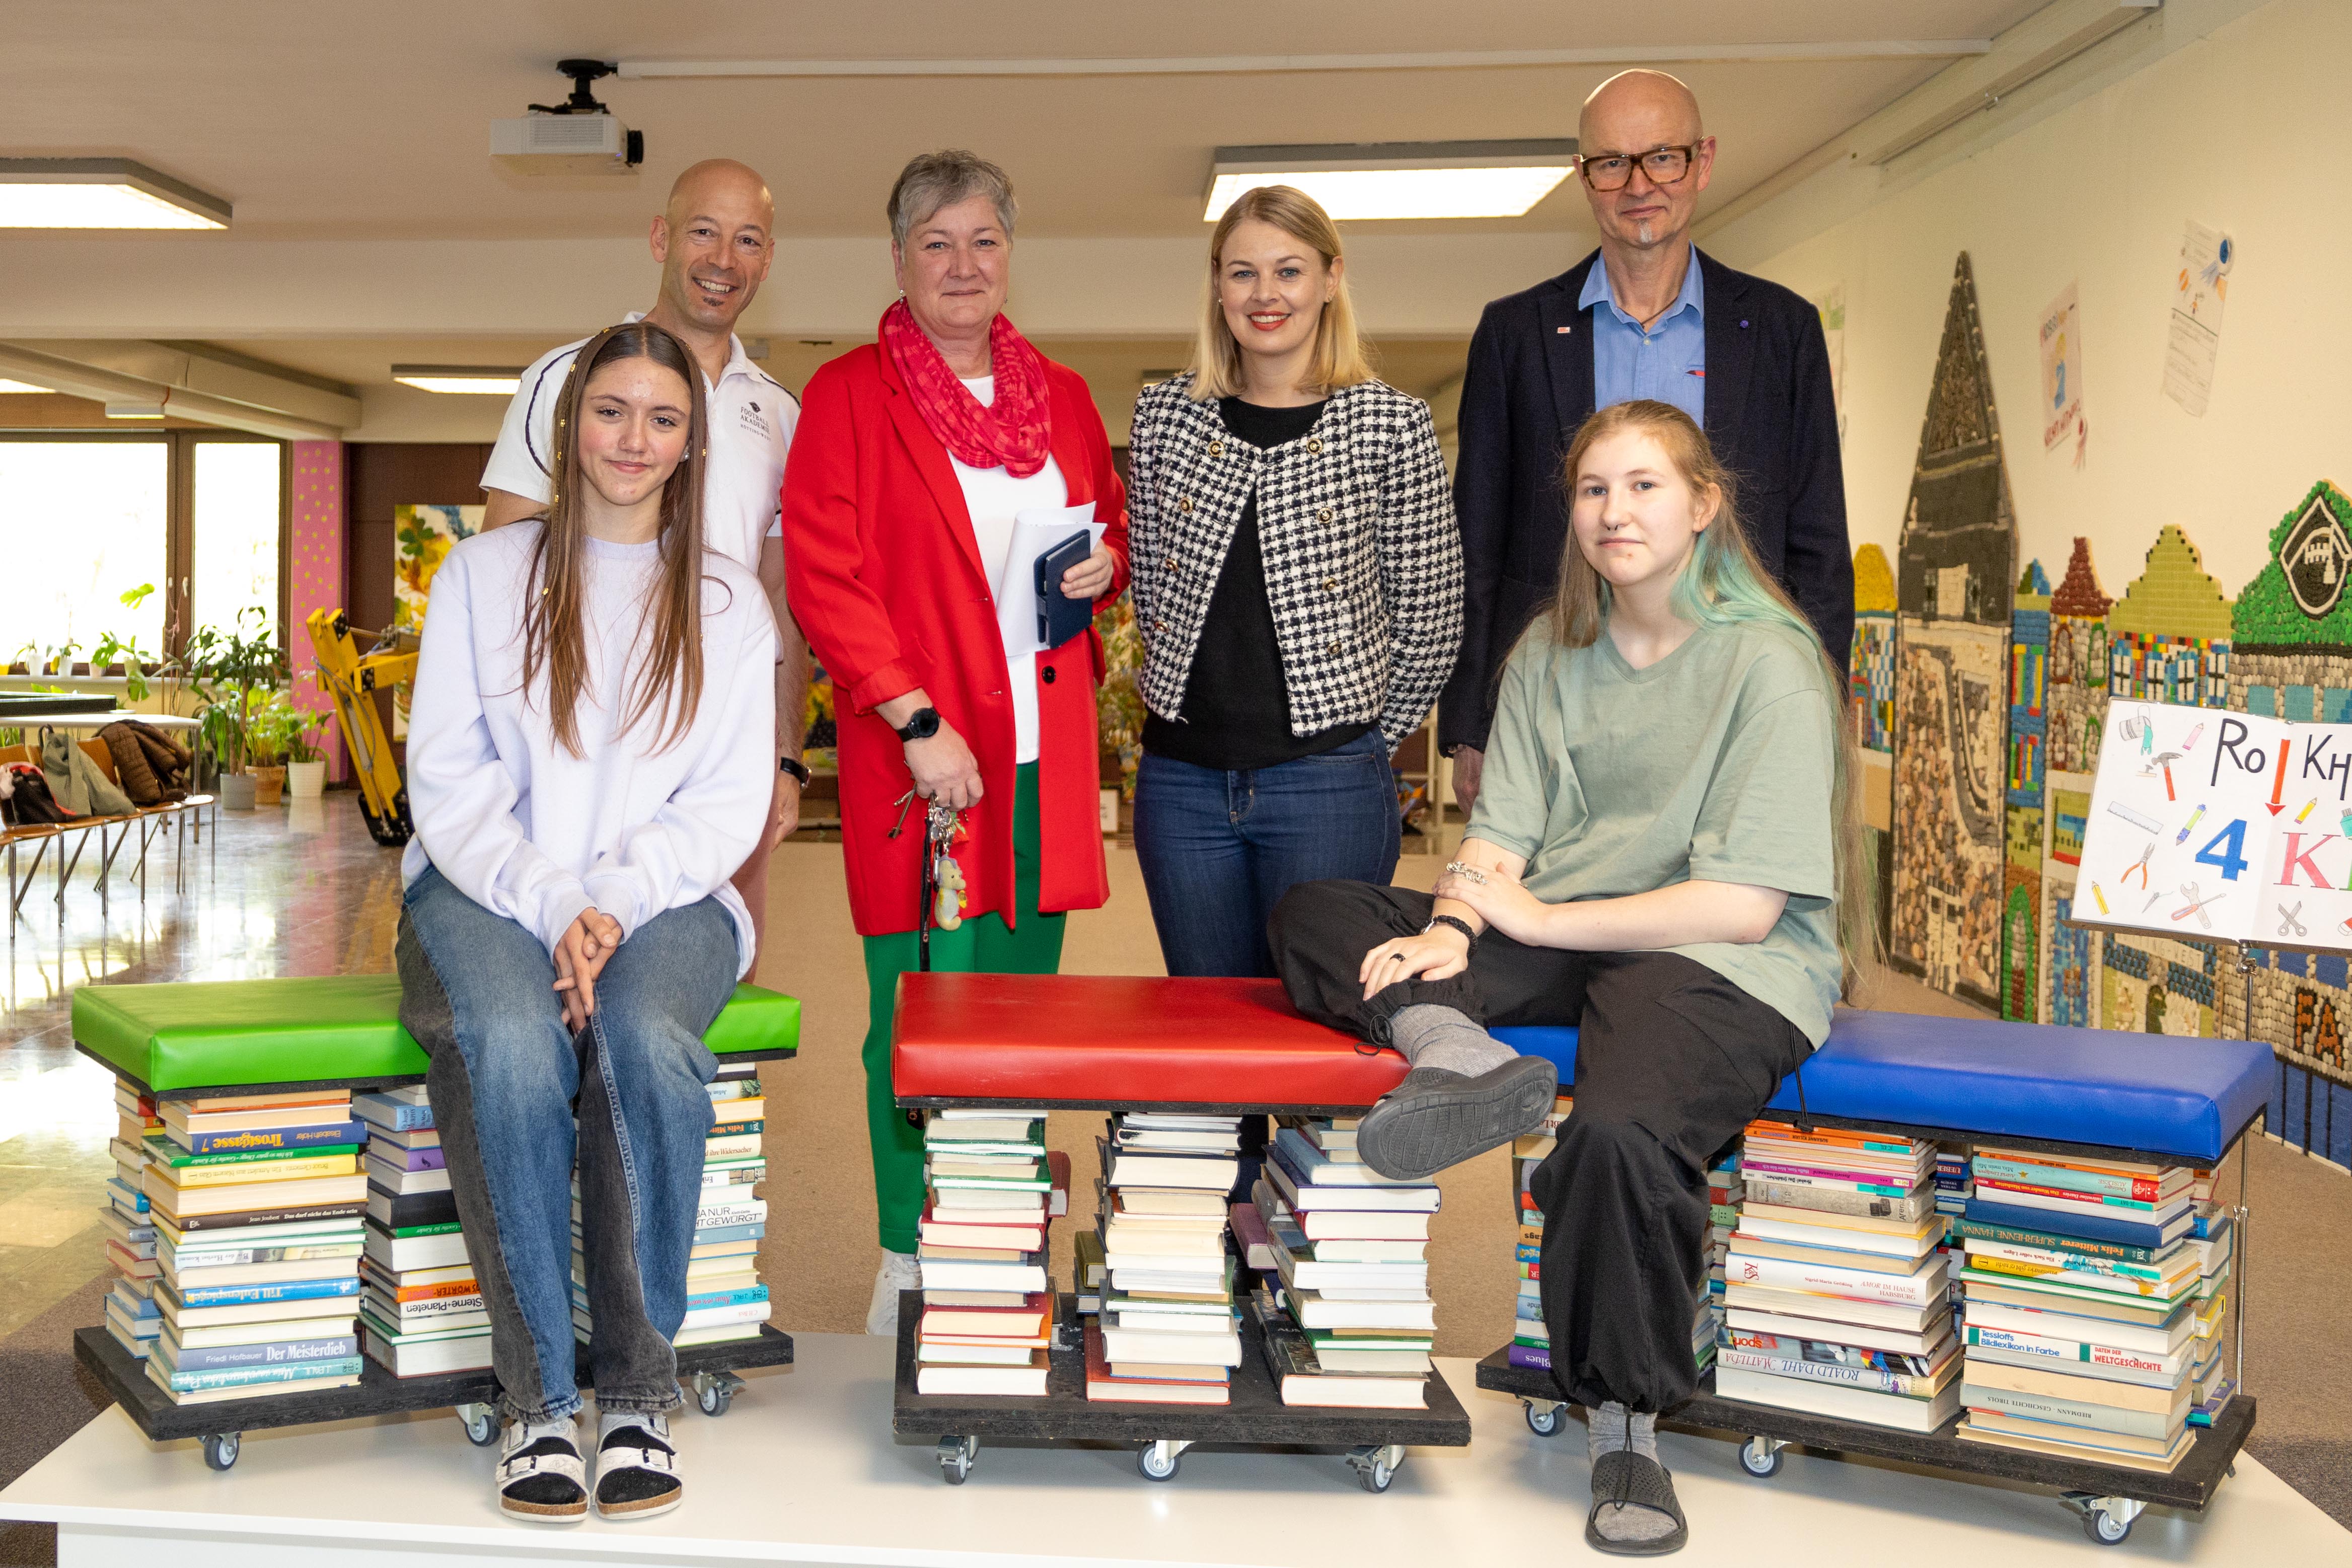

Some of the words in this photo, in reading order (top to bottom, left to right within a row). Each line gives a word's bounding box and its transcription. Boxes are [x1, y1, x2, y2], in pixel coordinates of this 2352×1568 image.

[741, 407, 770, 428] FOOTBALL
[741, 414, 770, 435] AKADEMIE
[2195, 818, 2248, 881] 4
[2273, 832, 2352, 891] K
[727, 1124, 745, 1133] Felix
[296, 1132, 313, 1140] Hofer
[314, 1130, 341, 1139] Elisabeth
[201, 1138, 209, 1152] 7
[212, 1132, 284, 1149] Trostgasse
[720, 1146, 752, 1155] Widersacher
[1976, 1168, 2000, 1176] Lindgren
[2000, 1171, 2016, 1179] Astrid
[1995, 1181, 2020, 1190] Manhattan
[2098, 1178, 2127, 1187] AUSLESE
[2103, 1183, 2126, 1192] Oetinger
[2030, 1187, 2049, 1195] Wunder
[2062, 1191, 2079, 1200] Davies
[2079, 1193, 2102, 1203] Valentine
[708, 1207, 730, 1217] NUR
[1961, 1225, 1994, 1239] HANNA
[1997, 1229, 2055, 1247] SUPERHENNE
[2061, 1239, 2099, 1253] Mitterer
[2101, 1244, 2124, 1257] Felix
[2003, 1249, 2018, 1257] Lügen
[1804, 1277, 1832, 1286] Sigrid-Maria
[1860, 1281, 1881, 1290] AMOR
[1893, 1285, 1916, 1294] HAUSE
[263, 1288, 282, 1298] Till
[1879, 1289, 1916, 1300] HABSBURG
[1981, 1329, 2014, 1342] Tessloffs
[1533, 1340, 1550, 1349] Kinder
[1981, 1337, 2025, 1352] Bildlexikon
[2026, 1344, 2034, 1353] in
[2035, 1345, 2060, 1357] Farbe
[206, 1355, 227, 1363] Friedl
[229, 1353, 262, 1361] Hofbauer
[266, 1346, 285, 1361] Der
[286, 1341, 346, 1360] Meisterdieb
[2094, 1346, 2111, 1355] DATEN
[1525, 1355, 1551, 1368] Blues
[1724, 1353, 1777, 1371] MATILDA
[2094, 1354, 2162, 1372] WELTGESCHICHTE
[1781, 1360, 1815, 1375] DAHL
[1817, 1365, 1860, 1381] ROALD
[1987, 1396, 2010, 1405] TIROLS
[2011, 1400, 2051, 1411] GESCHICHTE
[2057, 1408, 2092, 1419] RIEDMANN
